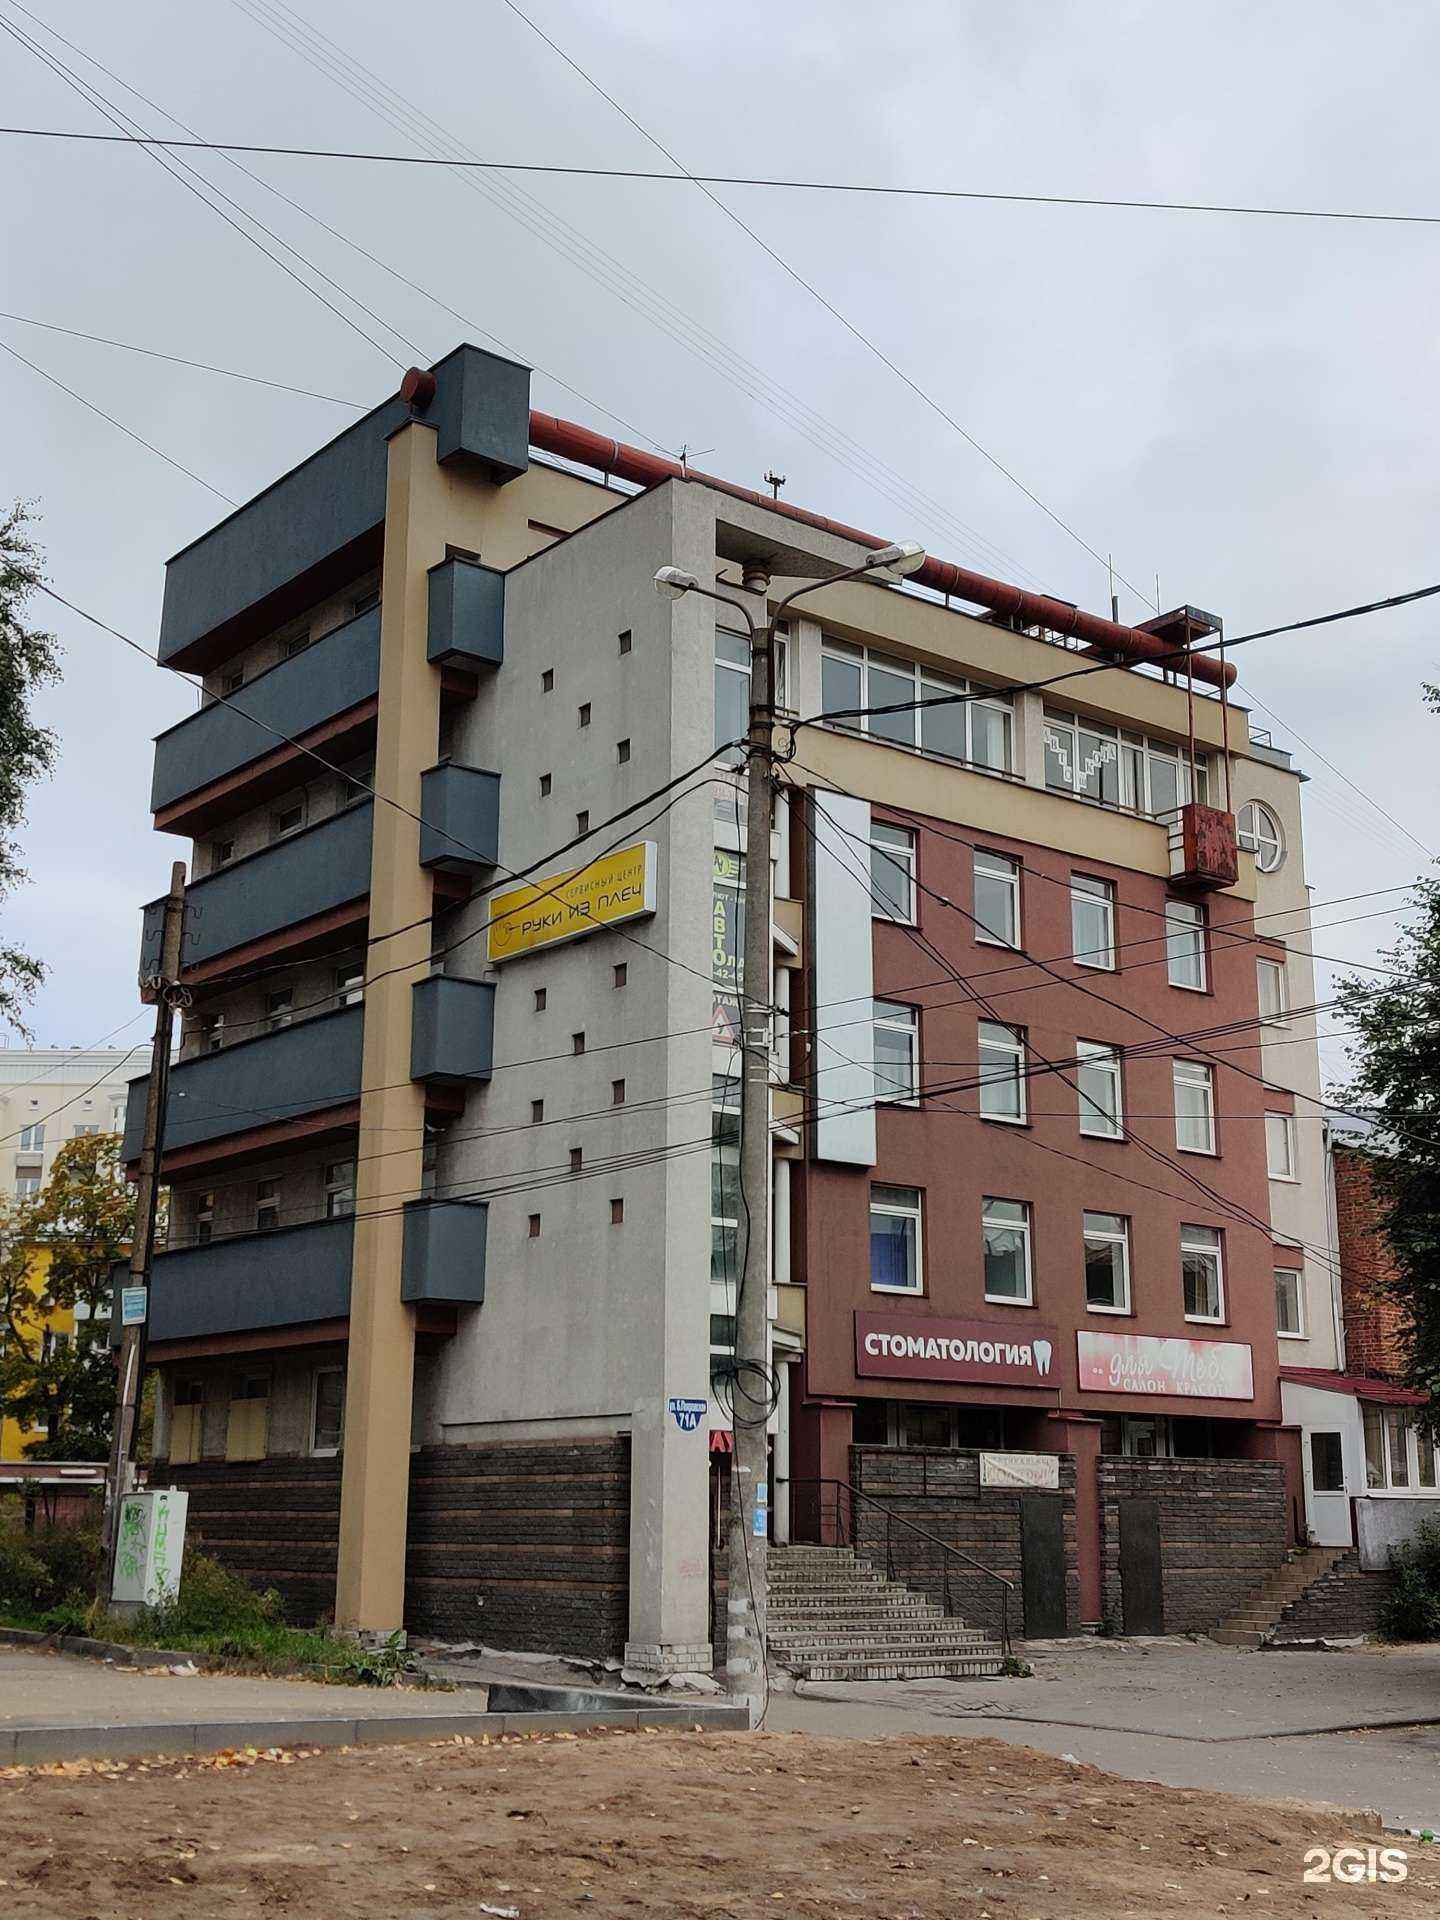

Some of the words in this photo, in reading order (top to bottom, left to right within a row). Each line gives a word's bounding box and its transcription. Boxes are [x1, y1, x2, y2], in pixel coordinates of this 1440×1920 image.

[567, 873, 614, 898] СЕРВИСНЫЙ
[617, 864, 642, 882] ЦЕНТР
[521, 910, 563, 936] РУКИ
[569, 901, 590, 919] ИЗ
[598, 883, 642, 911] ПЛЕЧ
[864, 1332, 1033, 1367] СТОМАТОЛОГИЯ
